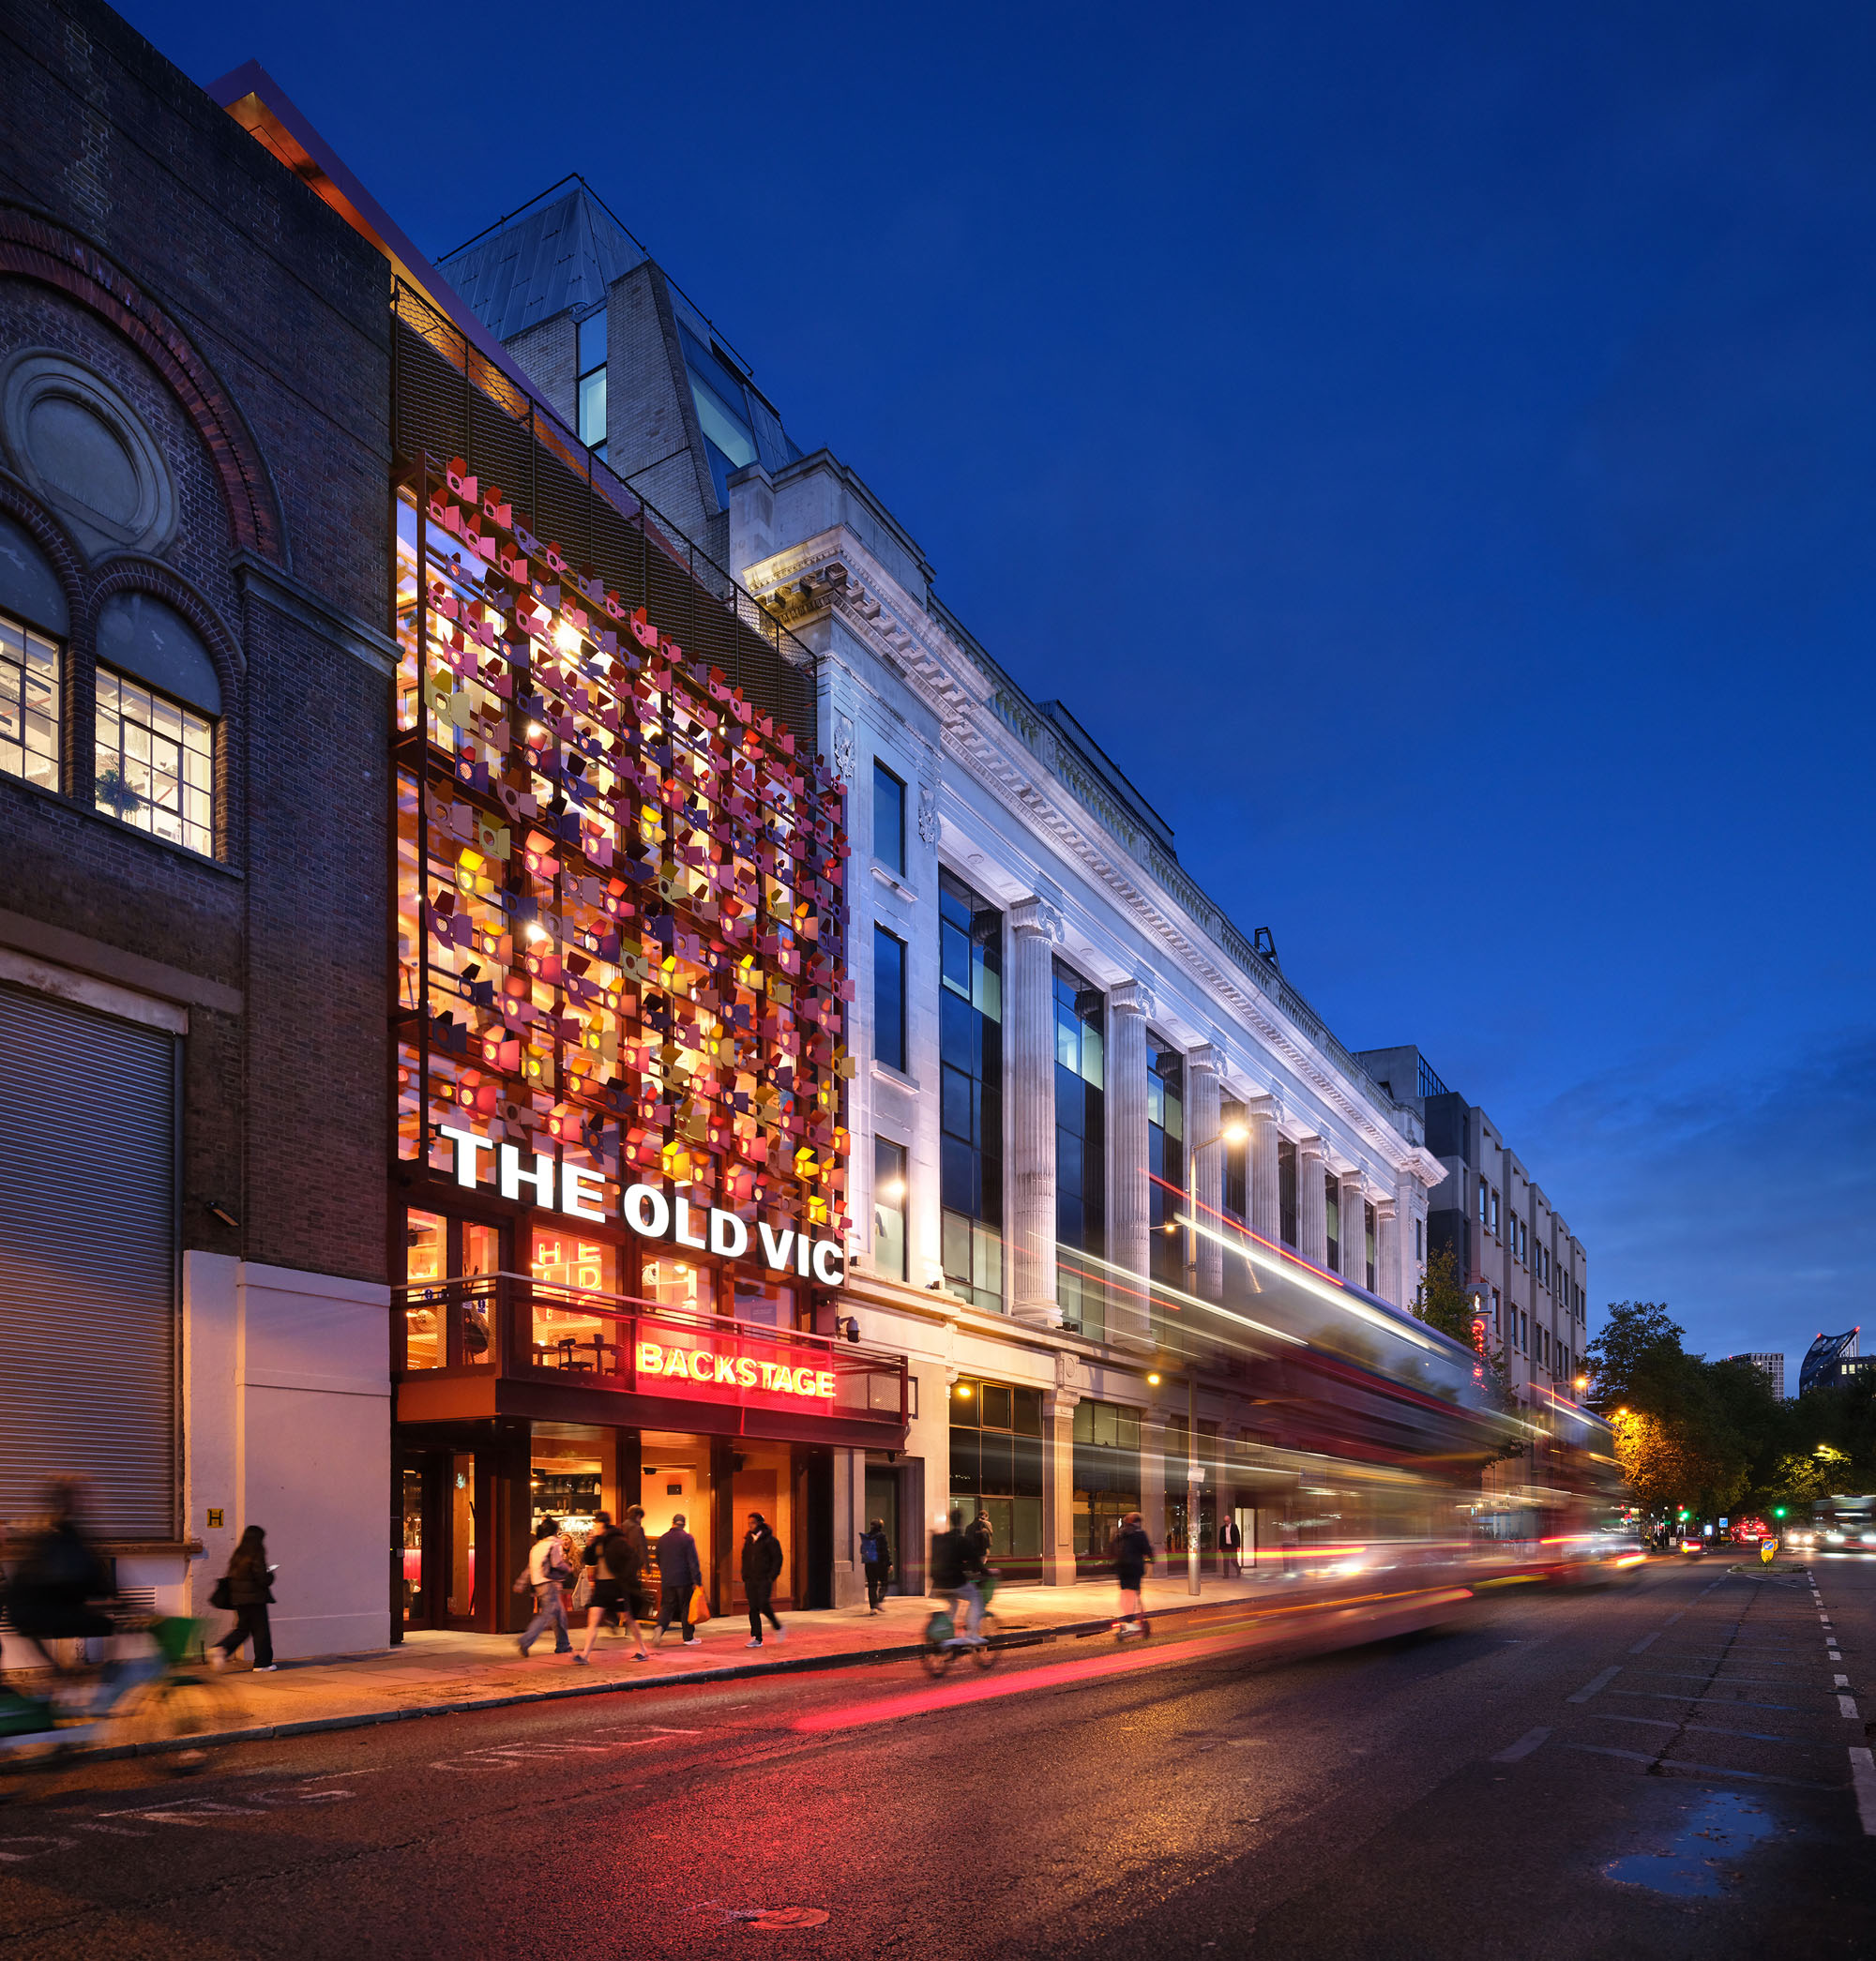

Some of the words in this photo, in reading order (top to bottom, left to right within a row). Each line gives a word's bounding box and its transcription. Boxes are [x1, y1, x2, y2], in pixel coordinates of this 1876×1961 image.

[441, 1124, 606, 1223] THE
[624, 1184, 748, 1258] OLD
[758, 1221, 844, 1286] VIC
[636, 1341, 838, 1398] BACKSTAGE
[206, 1508, 224, 1527] H
